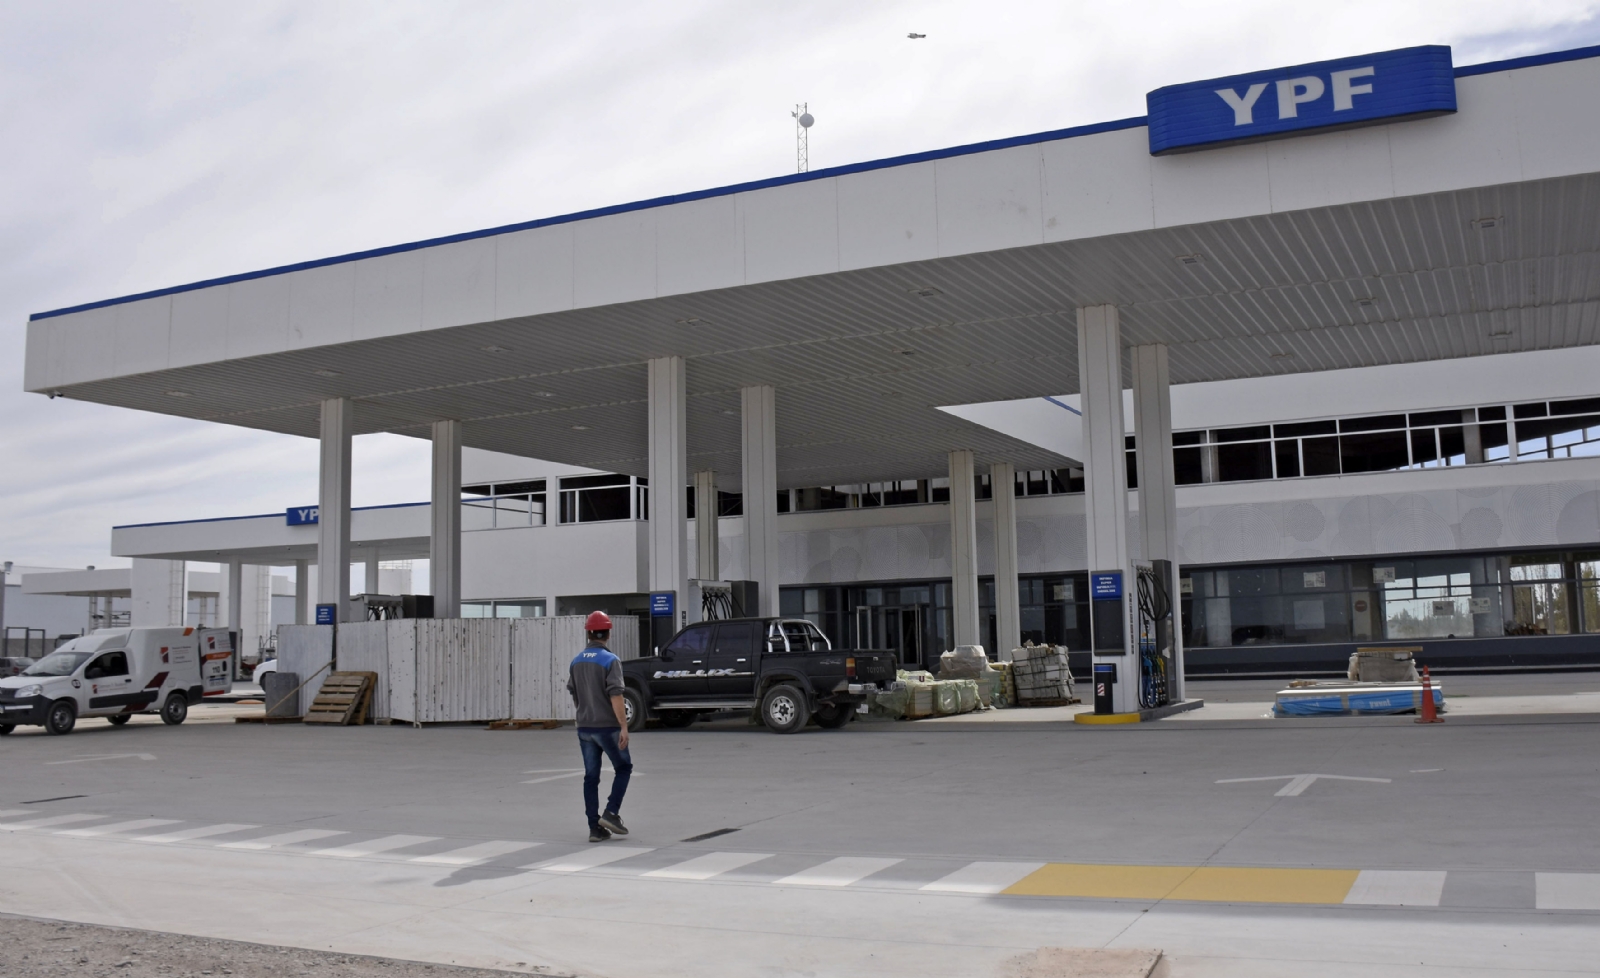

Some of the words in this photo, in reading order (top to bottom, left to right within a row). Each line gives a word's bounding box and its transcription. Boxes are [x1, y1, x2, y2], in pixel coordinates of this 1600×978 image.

[1214, 66, 1375, 126] YPF
[298, 508, 319, 521] YP
[653, 668, 736, 679] HILUX
[866, 666, 886, 674] TOYOTA
